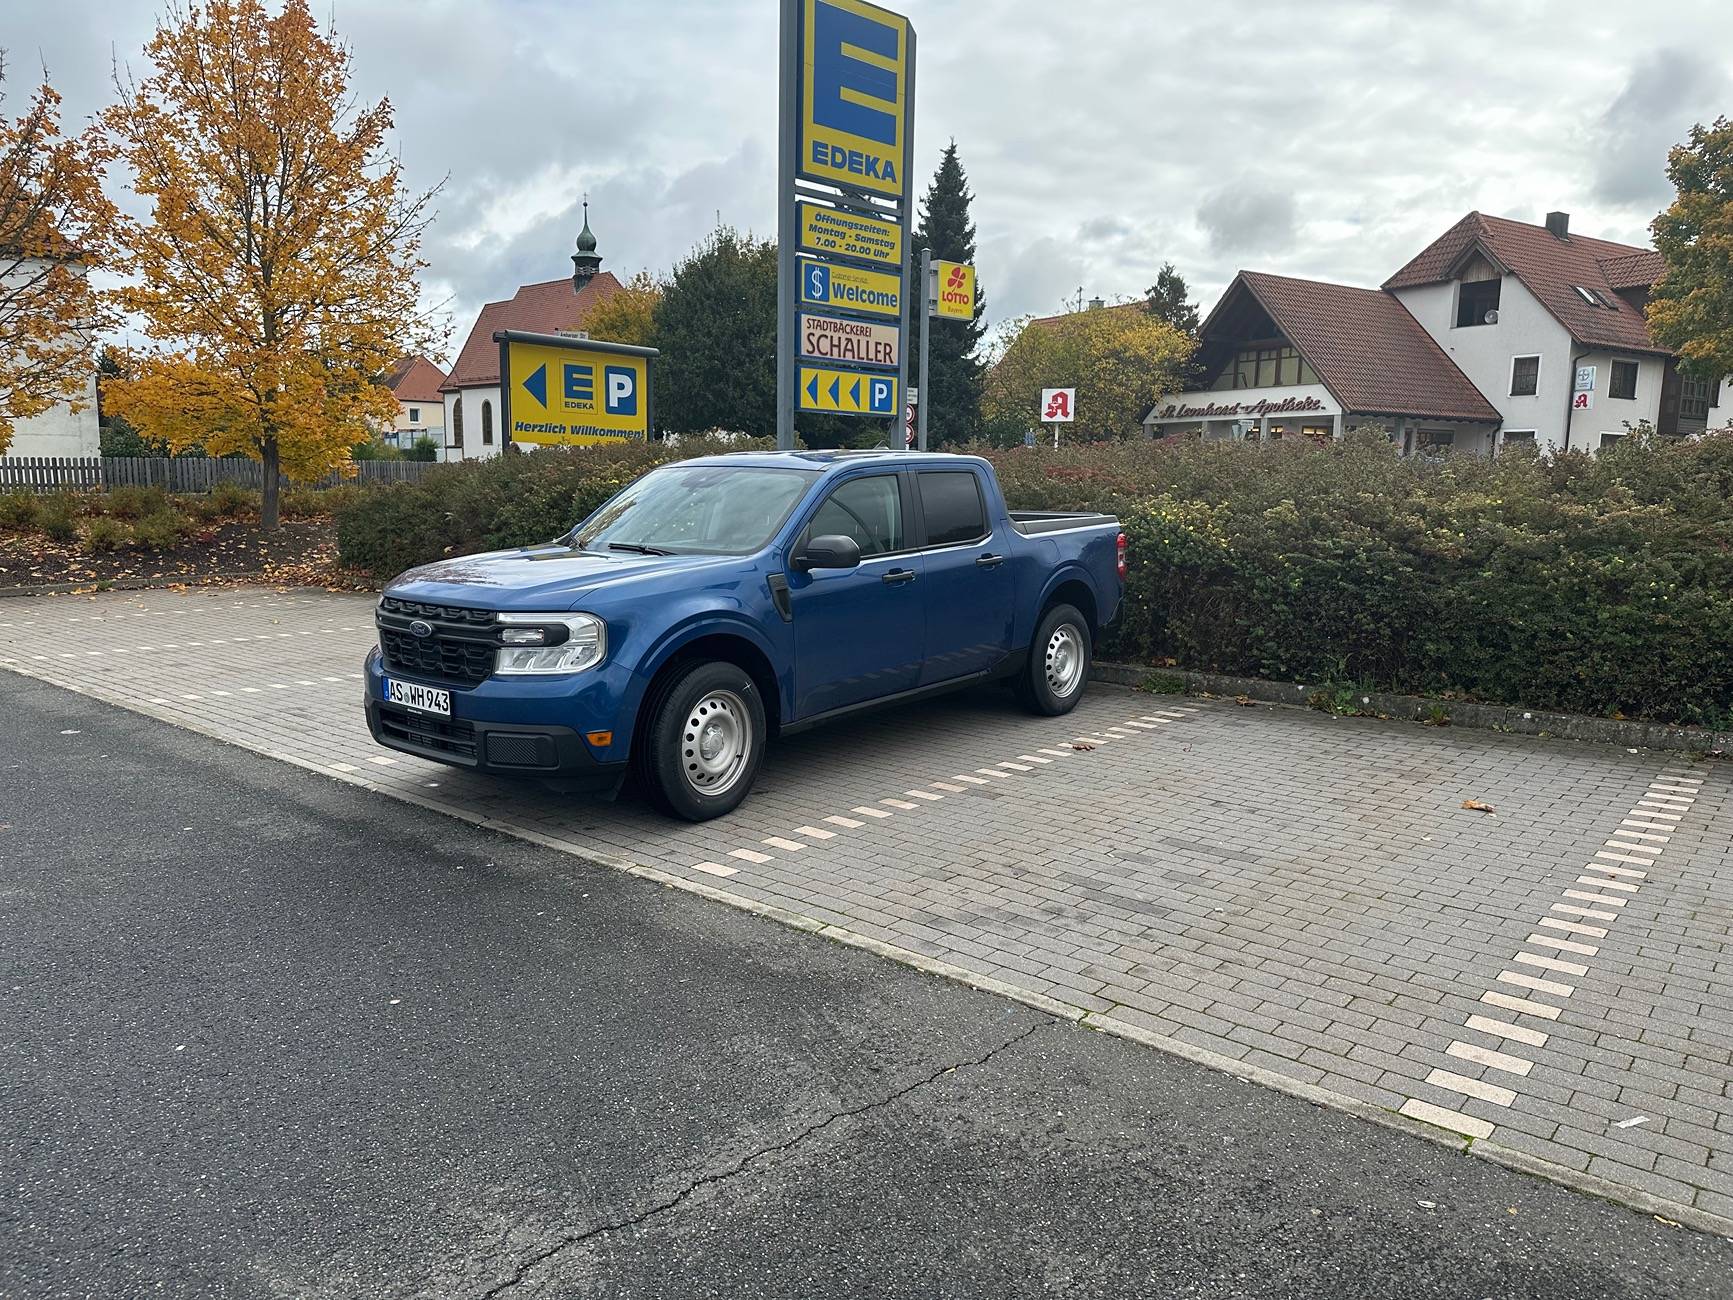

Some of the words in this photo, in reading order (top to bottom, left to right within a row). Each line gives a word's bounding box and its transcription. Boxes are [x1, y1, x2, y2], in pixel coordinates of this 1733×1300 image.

[812, 140, 897, 183] EDEKA
[808, 223, 846, 240] Montag
[854, 233, 895, 250] Samstag
[815, 212, 890, 237] Öffnungszeiten:
[815, 236, 836, 249] 7.00
[844, 243, 871, 256] 20.00
[873, 248, 889, 259] Uhr
[831, 282, 898, 308] Welcome
[942, 291, 969, 305] LOTTO
[806, 318, 872, 337] STADTBÄCKEREI
[806, 333, 893, 364] SCHALLER
[608, 373, 633, 408] P
[874, 383, 887, 407] P
[564, 401, 594, 410] EDEKA
[514, 421, 566, 434] Herzlich
[570, 425, 645, 439] Willkommen!
[390, 681, 403, 701] AS
